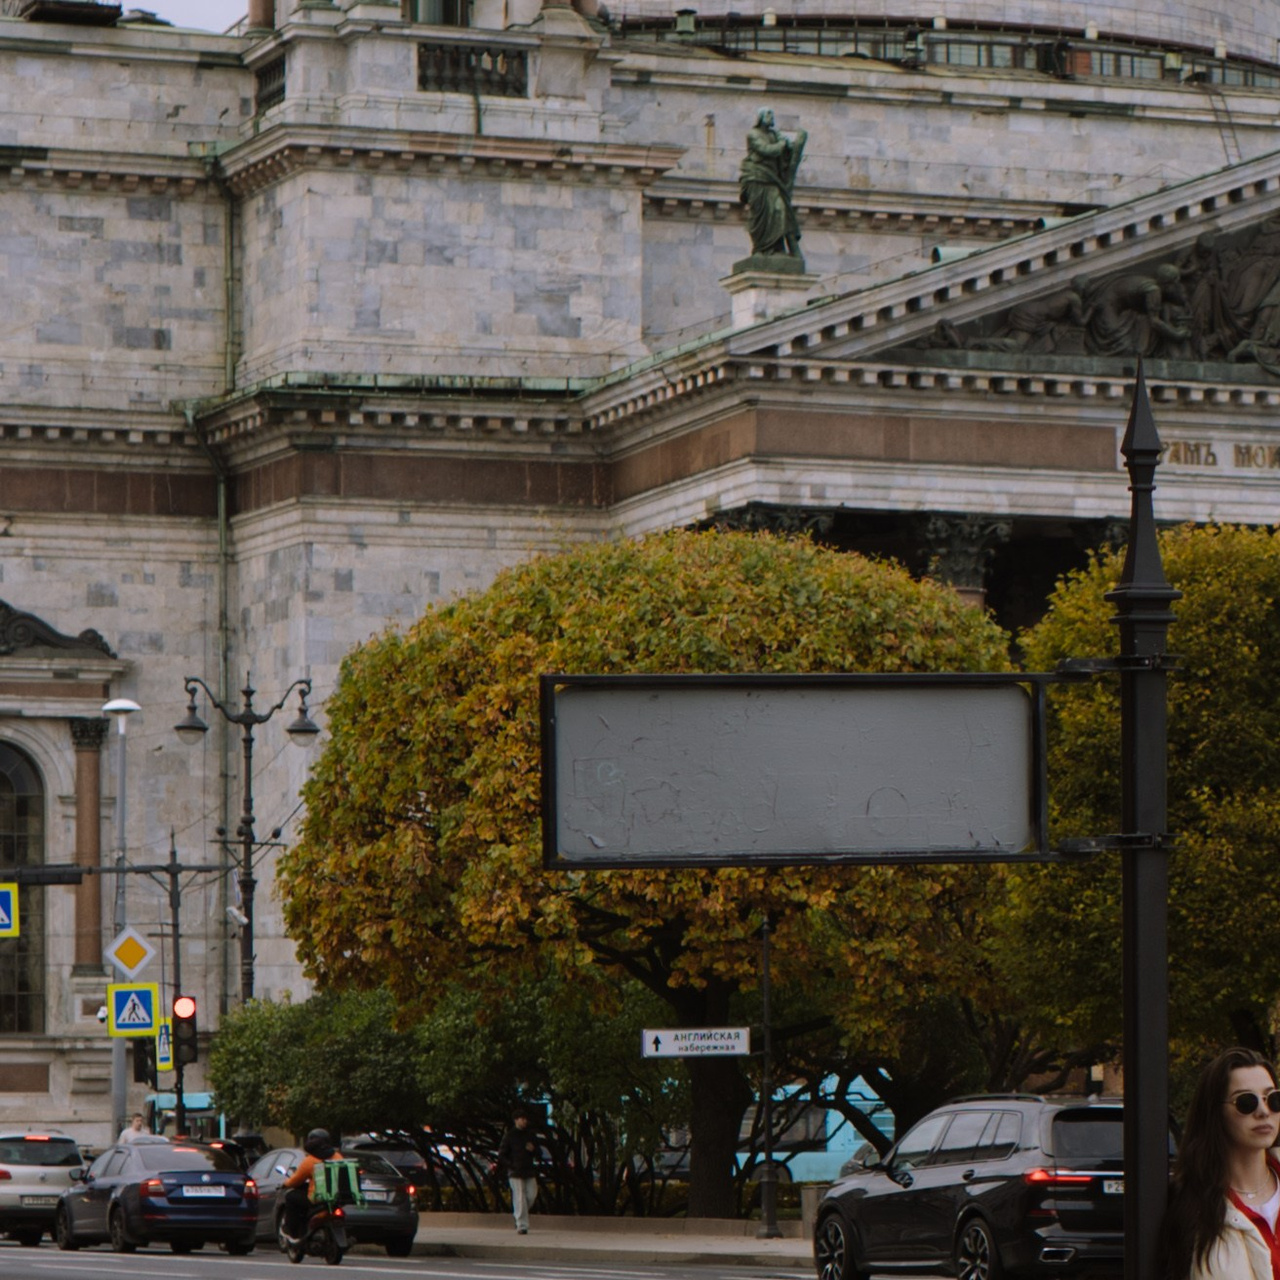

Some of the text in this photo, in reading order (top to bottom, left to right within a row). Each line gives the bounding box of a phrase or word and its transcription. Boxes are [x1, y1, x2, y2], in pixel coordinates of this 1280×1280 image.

[1157, 441, 1218, 466] РАМЪ
[673, 1030, 740, 1042] АНГЛИЙСКАЯ
[678, 1042, 736, 1053] набережная
